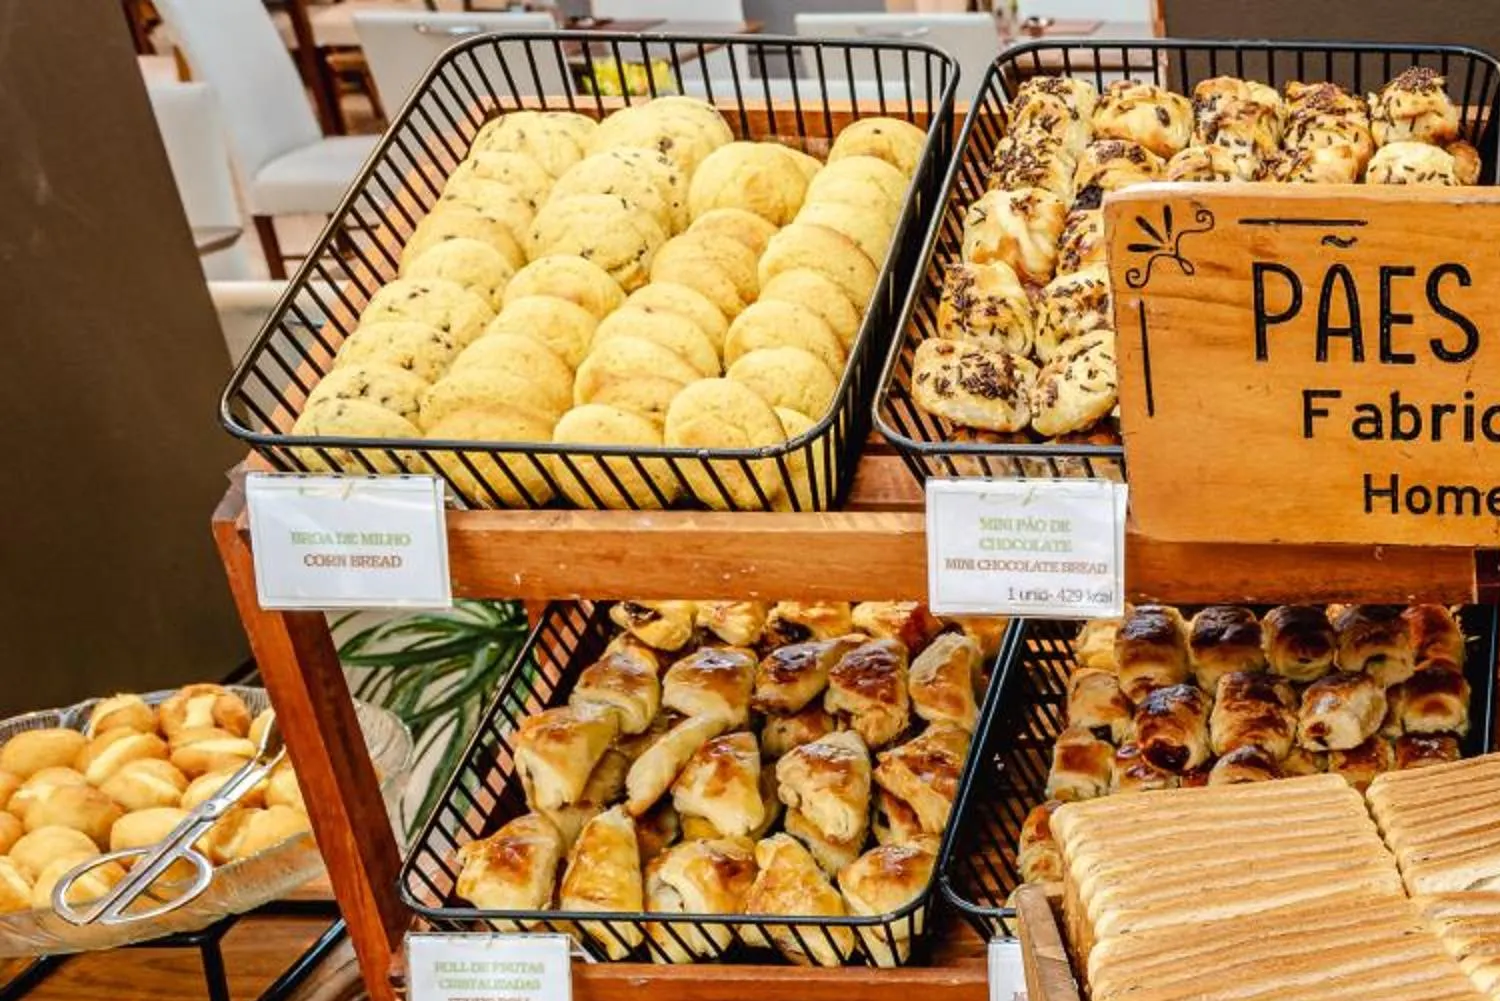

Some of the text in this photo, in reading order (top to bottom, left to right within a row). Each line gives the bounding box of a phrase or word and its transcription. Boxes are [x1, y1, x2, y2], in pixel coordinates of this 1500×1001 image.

[1251, 236, 1482, 367] PÃES
[979, 516, 1014, 531] MINI
[361, 532, 412, 546] MILHO
[979, 537, 1073, 552] CHOCOLATE
[303, 553, 403, 568] CORN BREAD
[944, 558, 1108, 575] MINI CHOCOLATE BREAD
